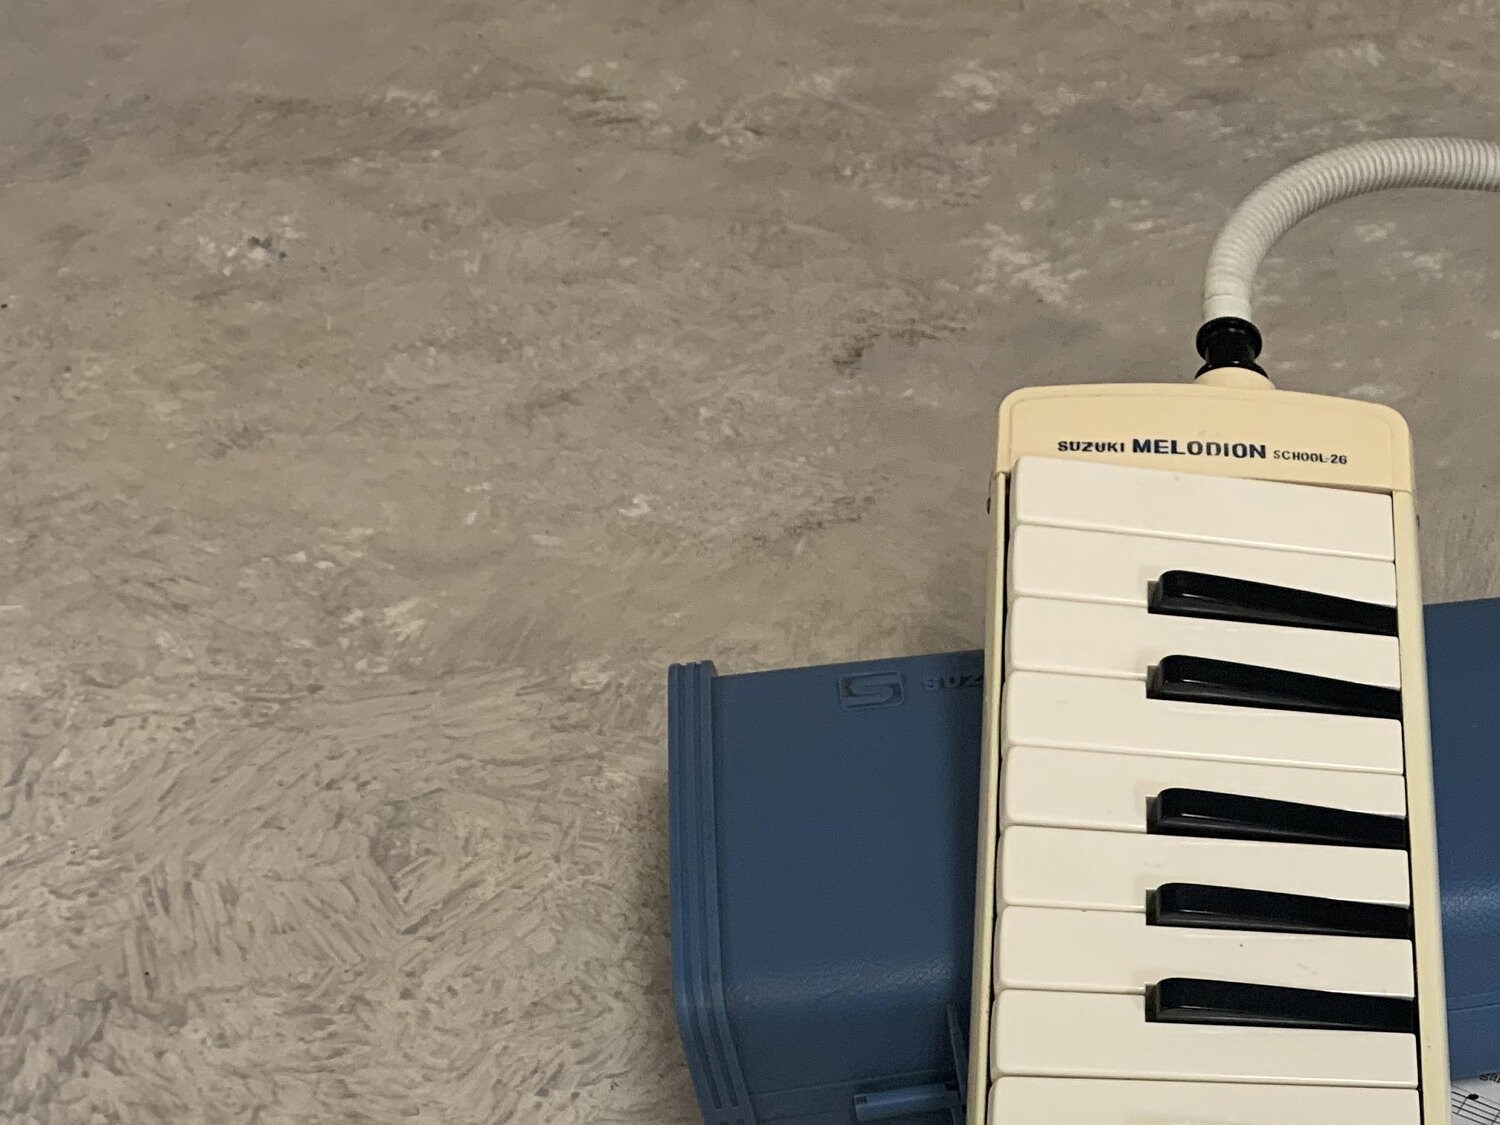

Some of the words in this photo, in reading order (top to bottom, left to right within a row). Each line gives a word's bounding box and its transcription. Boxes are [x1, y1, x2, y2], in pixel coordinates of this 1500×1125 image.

[1057, 440, 1125, 453] SUZUKI
[1131, 438, 1267, 460] MELODION
[1273, 449, 1348, 465] SCHOOL-26
